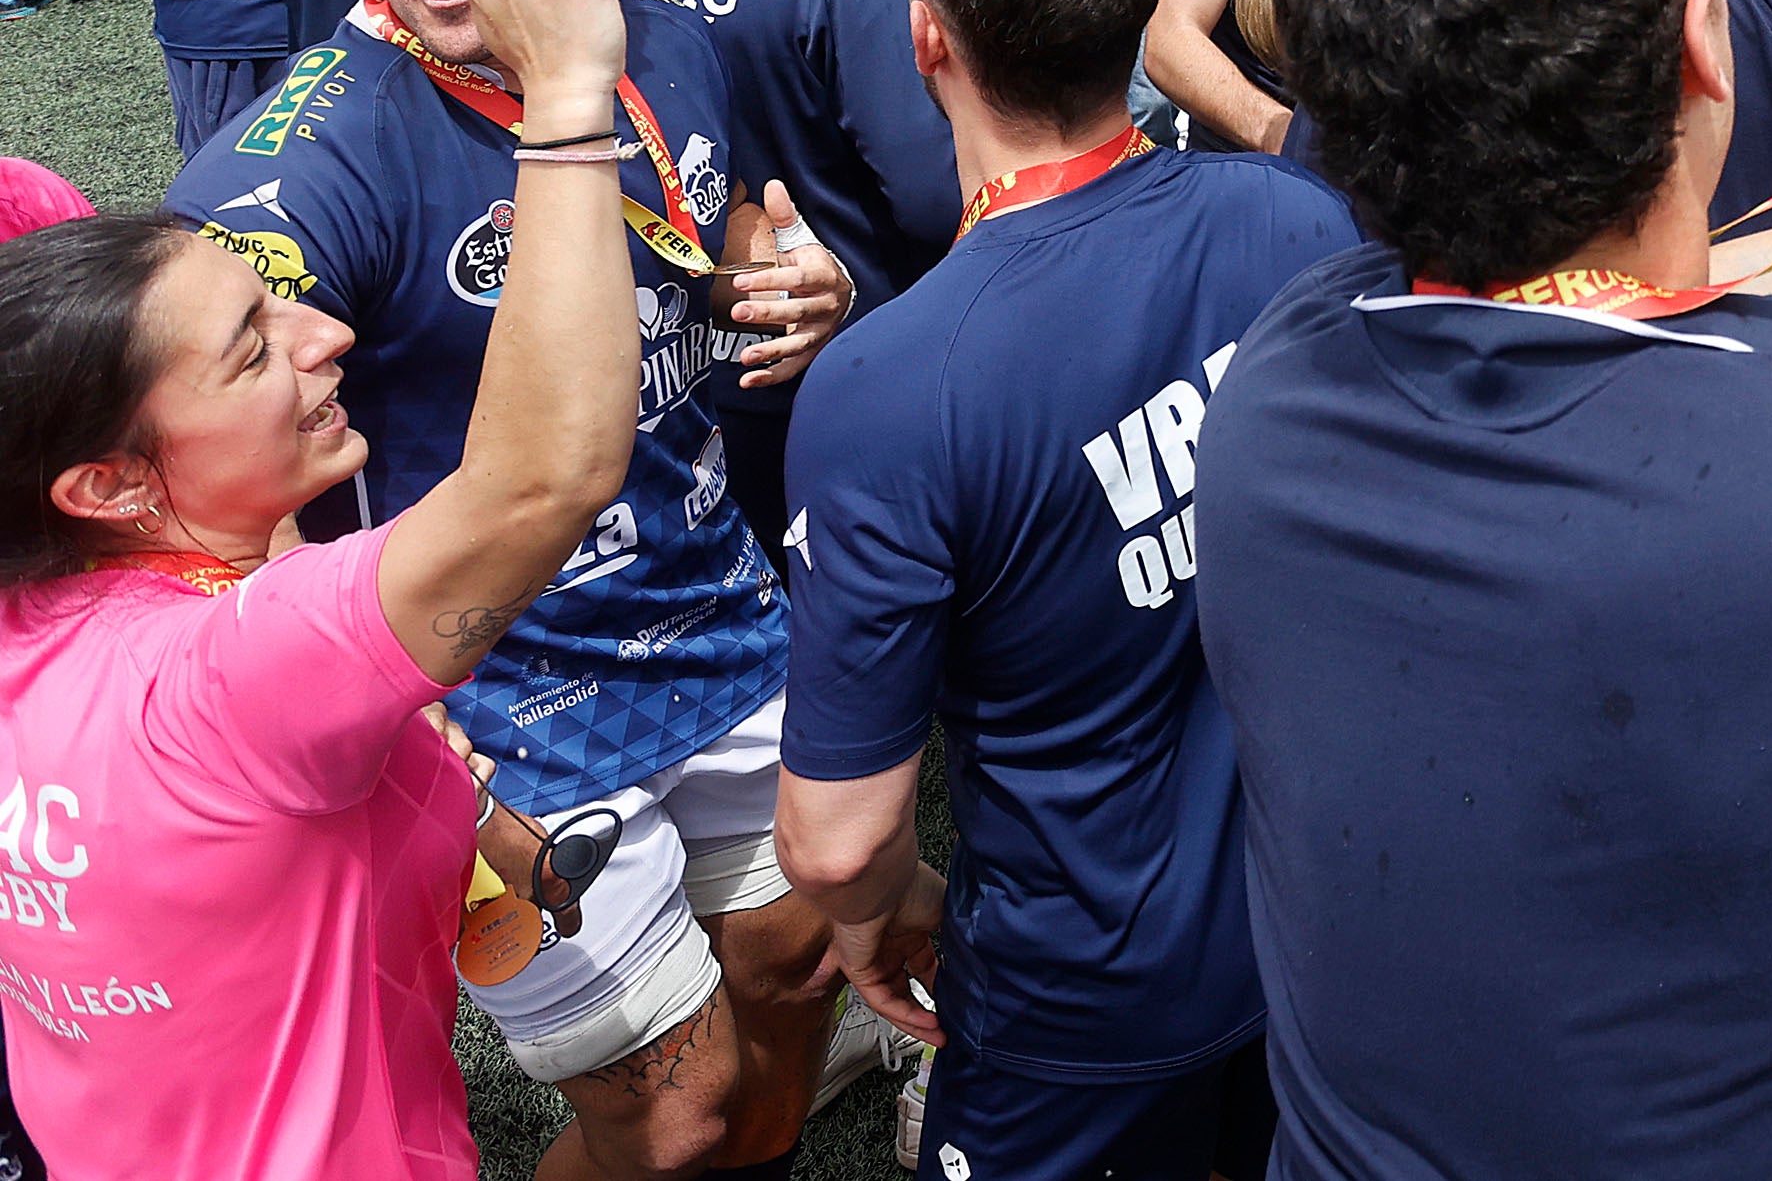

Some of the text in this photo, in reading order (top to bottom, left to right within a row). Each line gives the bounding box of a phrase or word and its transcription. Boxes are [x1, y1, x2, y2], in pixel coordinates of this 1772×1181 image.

[240, 48, 338, 154] RKD
[295, 68, 356, 142] PIVOT
[1081, 341, 1238, 532] VR
[637, 596, 718, 645] DIPUTACIÓN
[651, 606, 717, 655] DE VALLADOLID
[508, 670, 595, 714] Ayuntamiento de
[511, 680, 600, 729] Valladolid
[61, 975, 174, 1016] LEÓN
